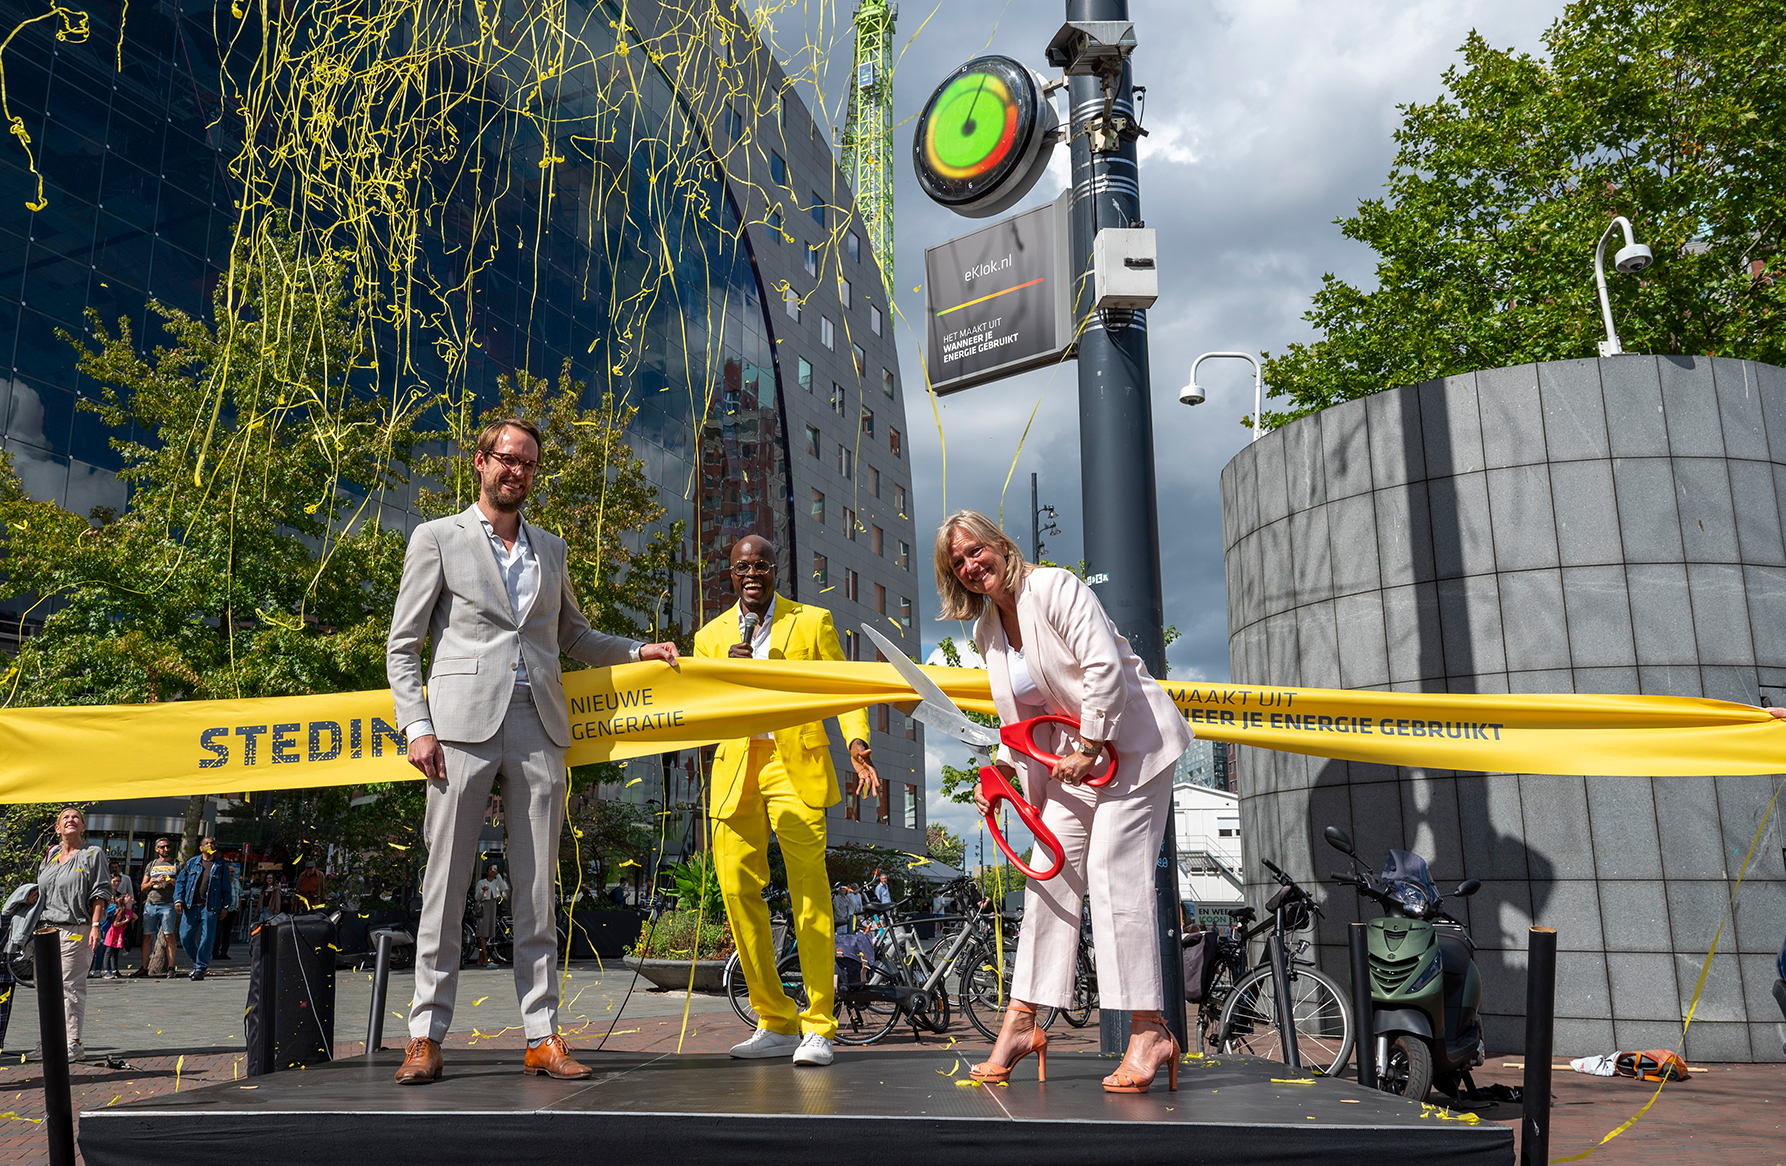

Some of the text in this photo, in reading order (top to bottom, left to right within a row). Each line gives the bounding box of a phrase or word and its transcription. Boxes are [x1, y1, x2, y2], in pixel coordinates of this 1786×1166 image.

[964, 253, 1012, 282] eKlok.nl
[943, 317, 1002, 344] HET MAAKT UIT
[943, 330, 993, 353] WANNEER JE
[943, 332, 1019, 363] ENERGIE GEBRUIKT
[571, 688, 653, 715] NIEUWE
[1167, 688, 1298, 707] MAAKT UIT
[572, 710, 685, 740] GENERATIE
[1178, 708, 1504, 740] NEER JE ENERGIE GEBRUIKT
[199, 717, 408, 768] STEDIN
[1211, 908, 1231, 916] WEE
